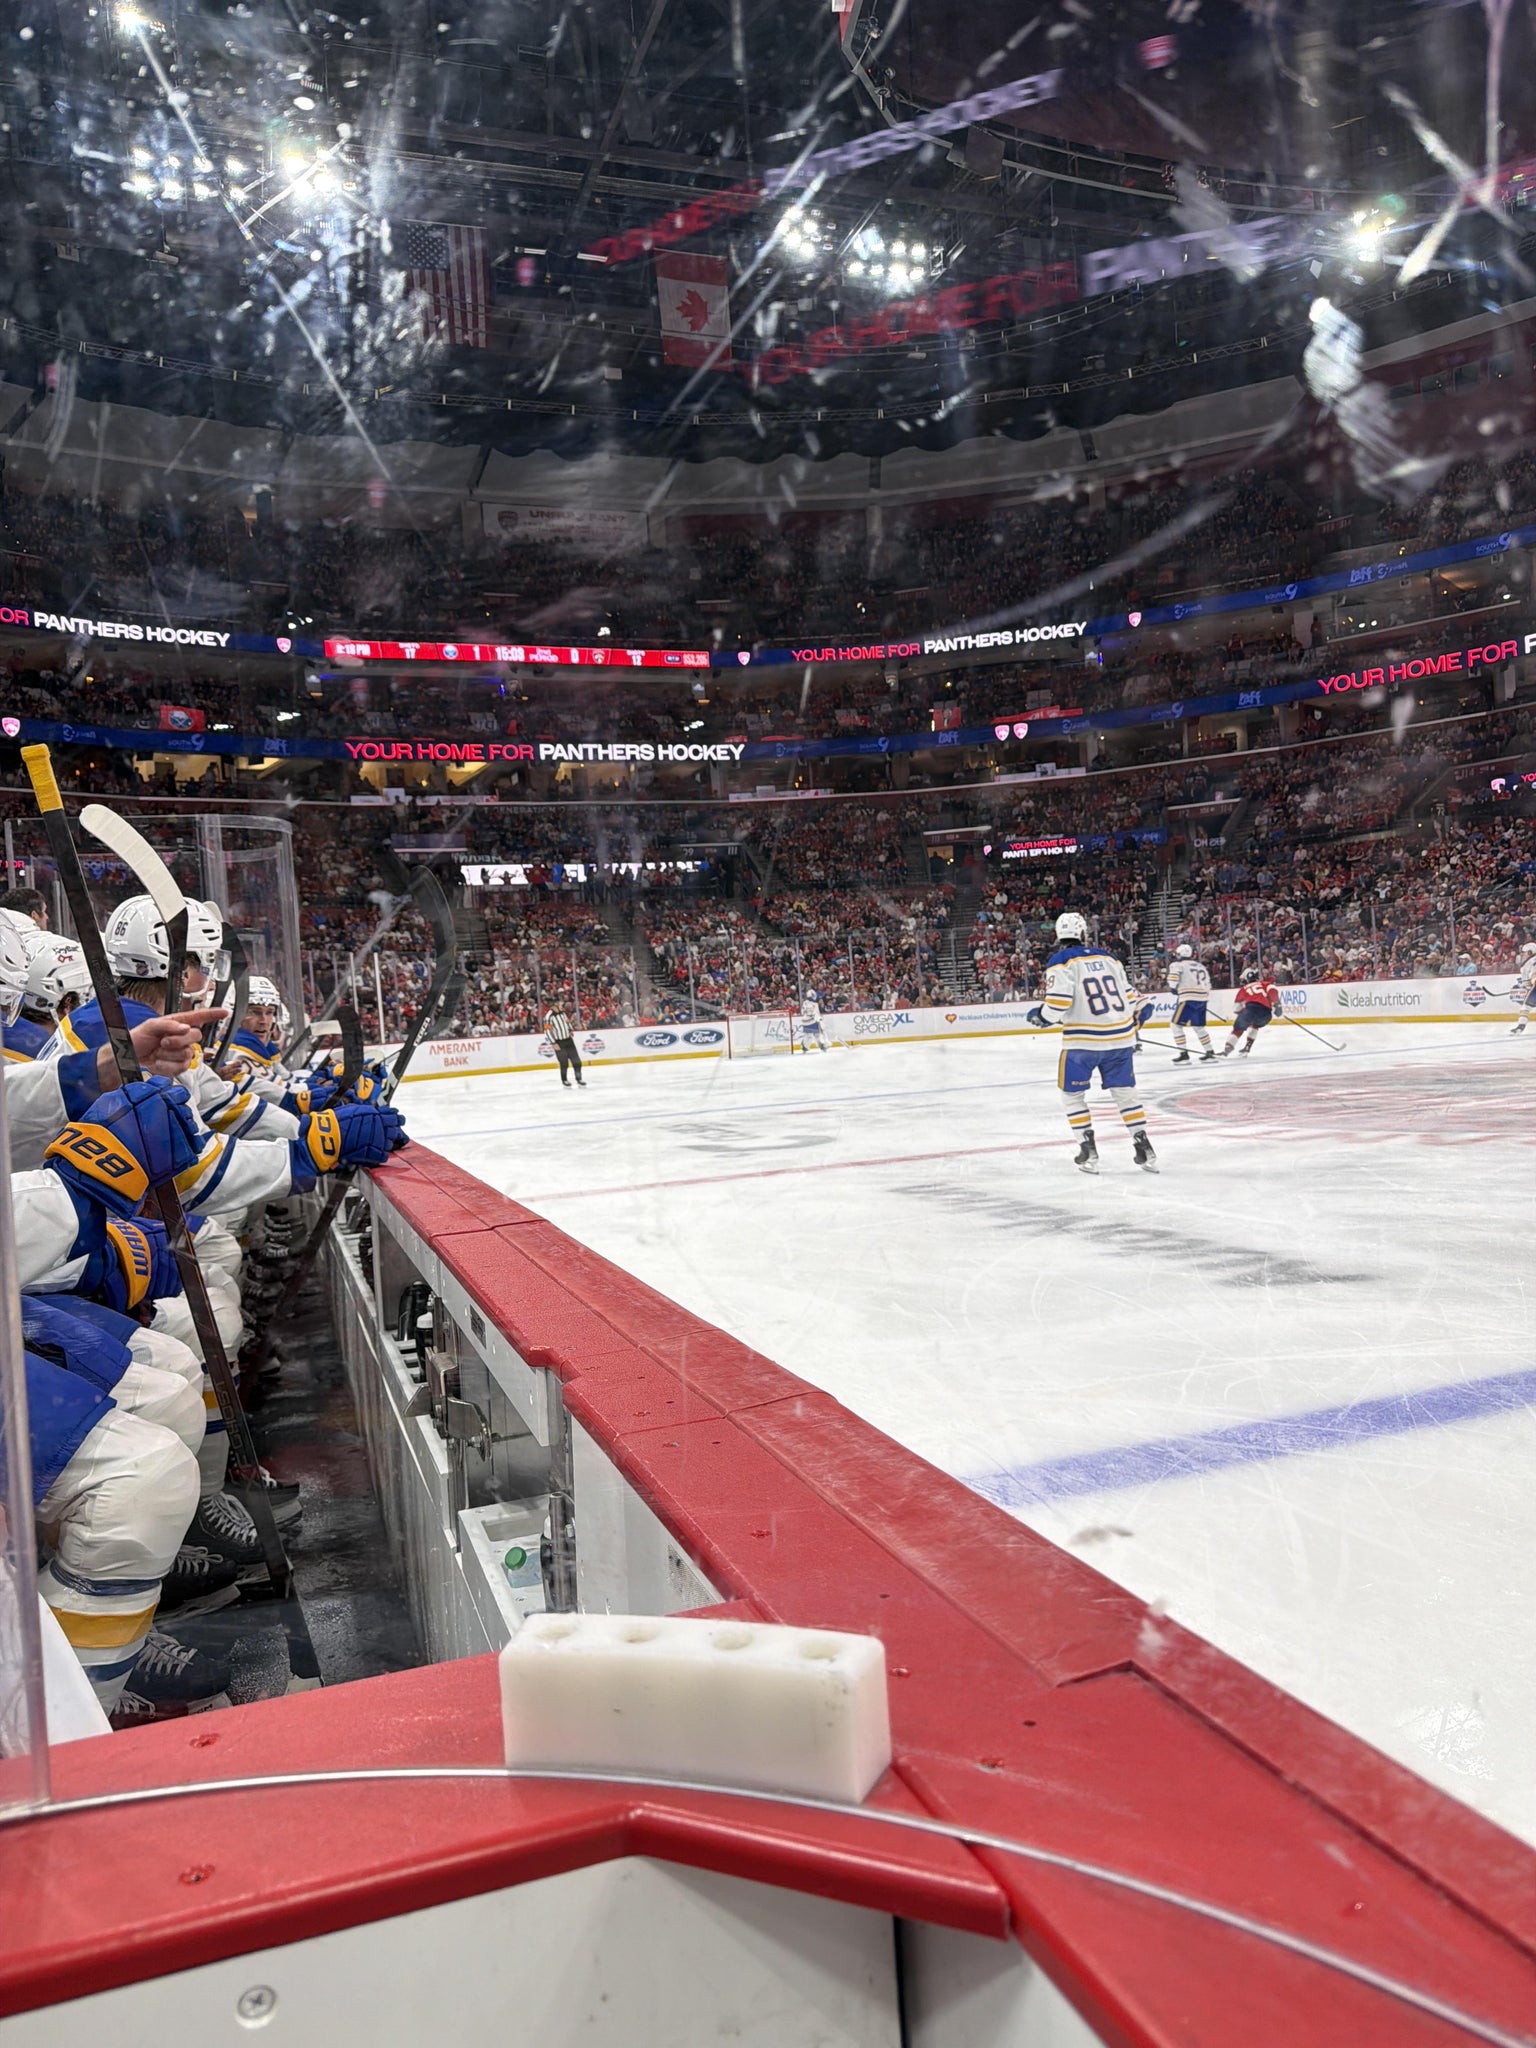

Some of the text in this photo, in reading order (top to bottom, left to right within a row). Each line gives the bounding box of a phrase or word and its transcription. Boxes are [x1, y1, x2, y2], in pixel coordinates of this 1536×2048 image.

[33, 611, 145, 641] PANTHERS
[146, 626, 231, 648] HOCKEY
[791, 621, 1087, 664] YOUR HOME FOR PANTHERS HOCKEY
[1317, 666, 1385, 695] YOUR
[1388, 651, 1463, 683] HOME
[1466, 639, 1519, 668] FOR
[345, 742, 746, 762] YOUR HOME FOR PANTHERS HOCKEY
[1009, 842, 1033, 851] YOUR
[1033, 839, 1058, 849] HOME
[1058, 837, 1077, 846] FOR
[114, 921, 128, 937] 86
[1084, 959, 1105, 973] TUCH
[1082, 974, 1126, 1016] 89
[1277, 989, 1307, 1006] WARD
[853, 1014, 893, 1026] OMEGA
[892, 1012, 914, 1027] XL
[854, 1023, 892, 1035] SPORT
[644, 1028, 717, 1047] Ford Ford
[429, 1041, 483, 1056] AMERANT
[444, 1056, 469, 1067] BANK
[316, 1110, 336, 1157] CC
